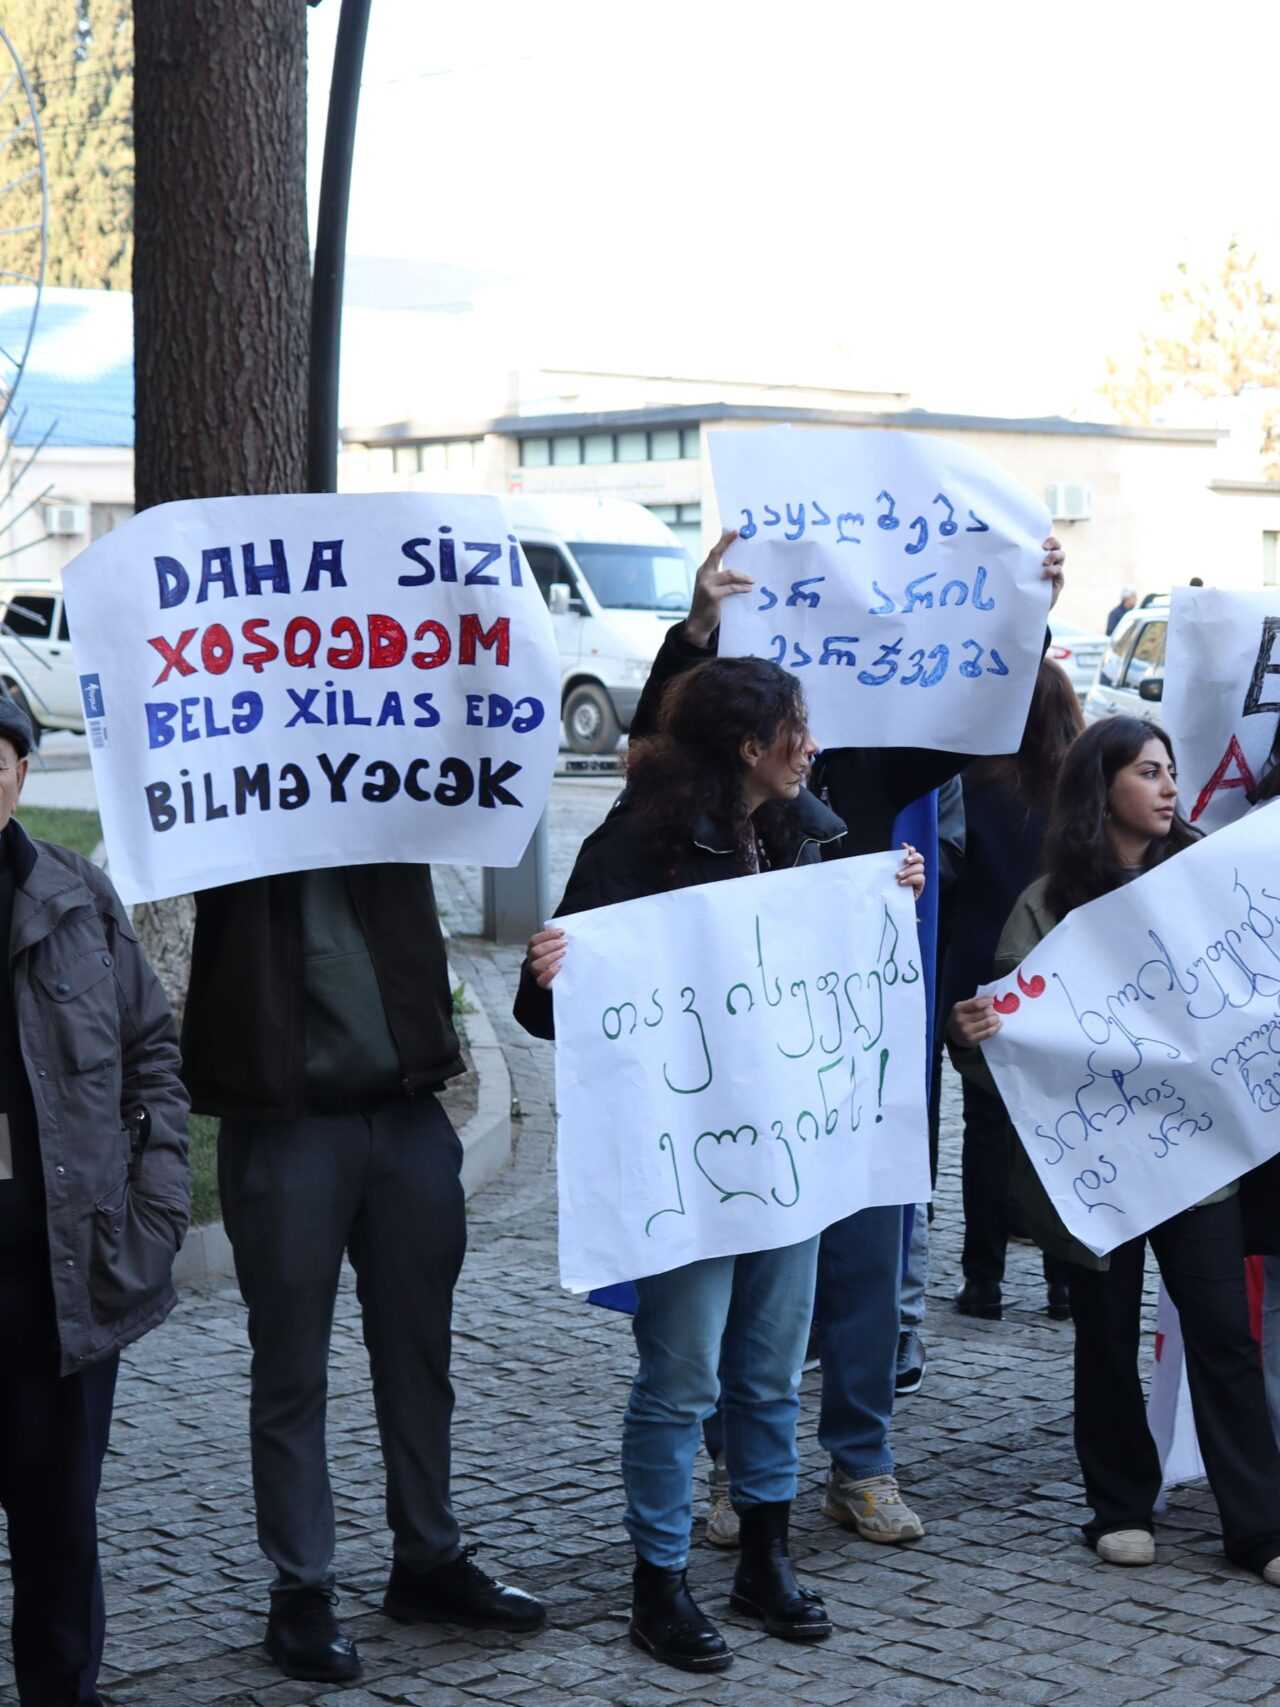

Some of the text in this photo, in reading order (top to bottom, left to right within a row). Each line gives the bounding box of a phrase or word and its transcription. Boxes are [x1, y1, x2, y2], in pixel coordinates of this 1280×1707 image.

[739, 489, 990, 554] გაყალბება
[153, 539, 347, 609] DAHA
[758, 566, 995, 614] არ არის
[767, 634, 1009, 688] მარჯვება
[144, 690, 264, 749] BELƏ
[284, 680, 441, 729] XİLAS
[465, 694, 545, 733] EDƏ
[1073, 1155, 1126, 1214] და
[1149, 1097, 1213, 1159] არა
